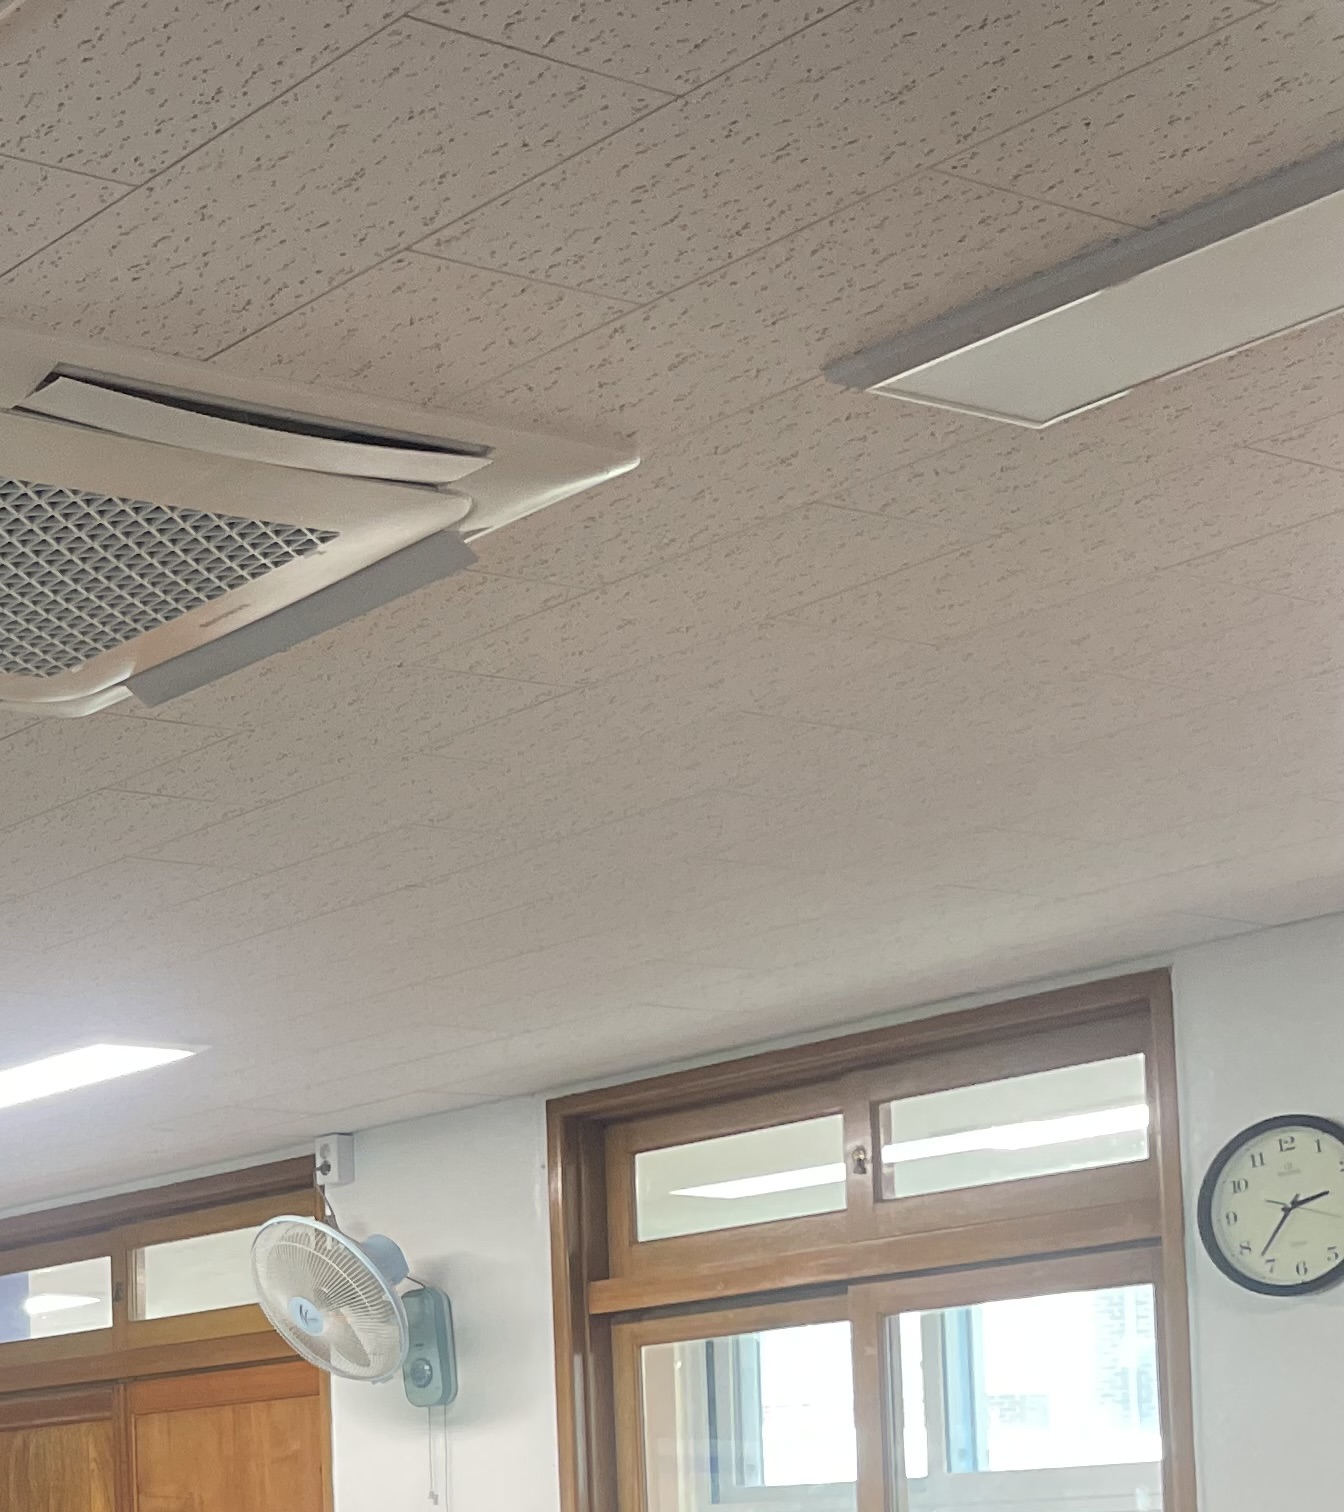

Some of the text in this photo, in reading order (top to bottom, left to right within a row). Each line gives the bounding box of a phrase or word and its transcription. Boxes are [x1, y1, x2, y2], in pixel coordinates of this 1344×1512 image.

[1278, 1136, 1296, 1152] 12
[1315, 1138, 1322, 1153] 1
[1250, 1152, 1266, 1168] 11
[1230, 1178, 1249, 1194] 10
[1226, 1211, 1238, 1226] 9
[1239, 1241, 1252, 1255] 8
[1327, 1246, 1339, 1262] 5
[1265, 1258, 1276, 1273] 7
[1296, 1260, 1308, 1276] 6
